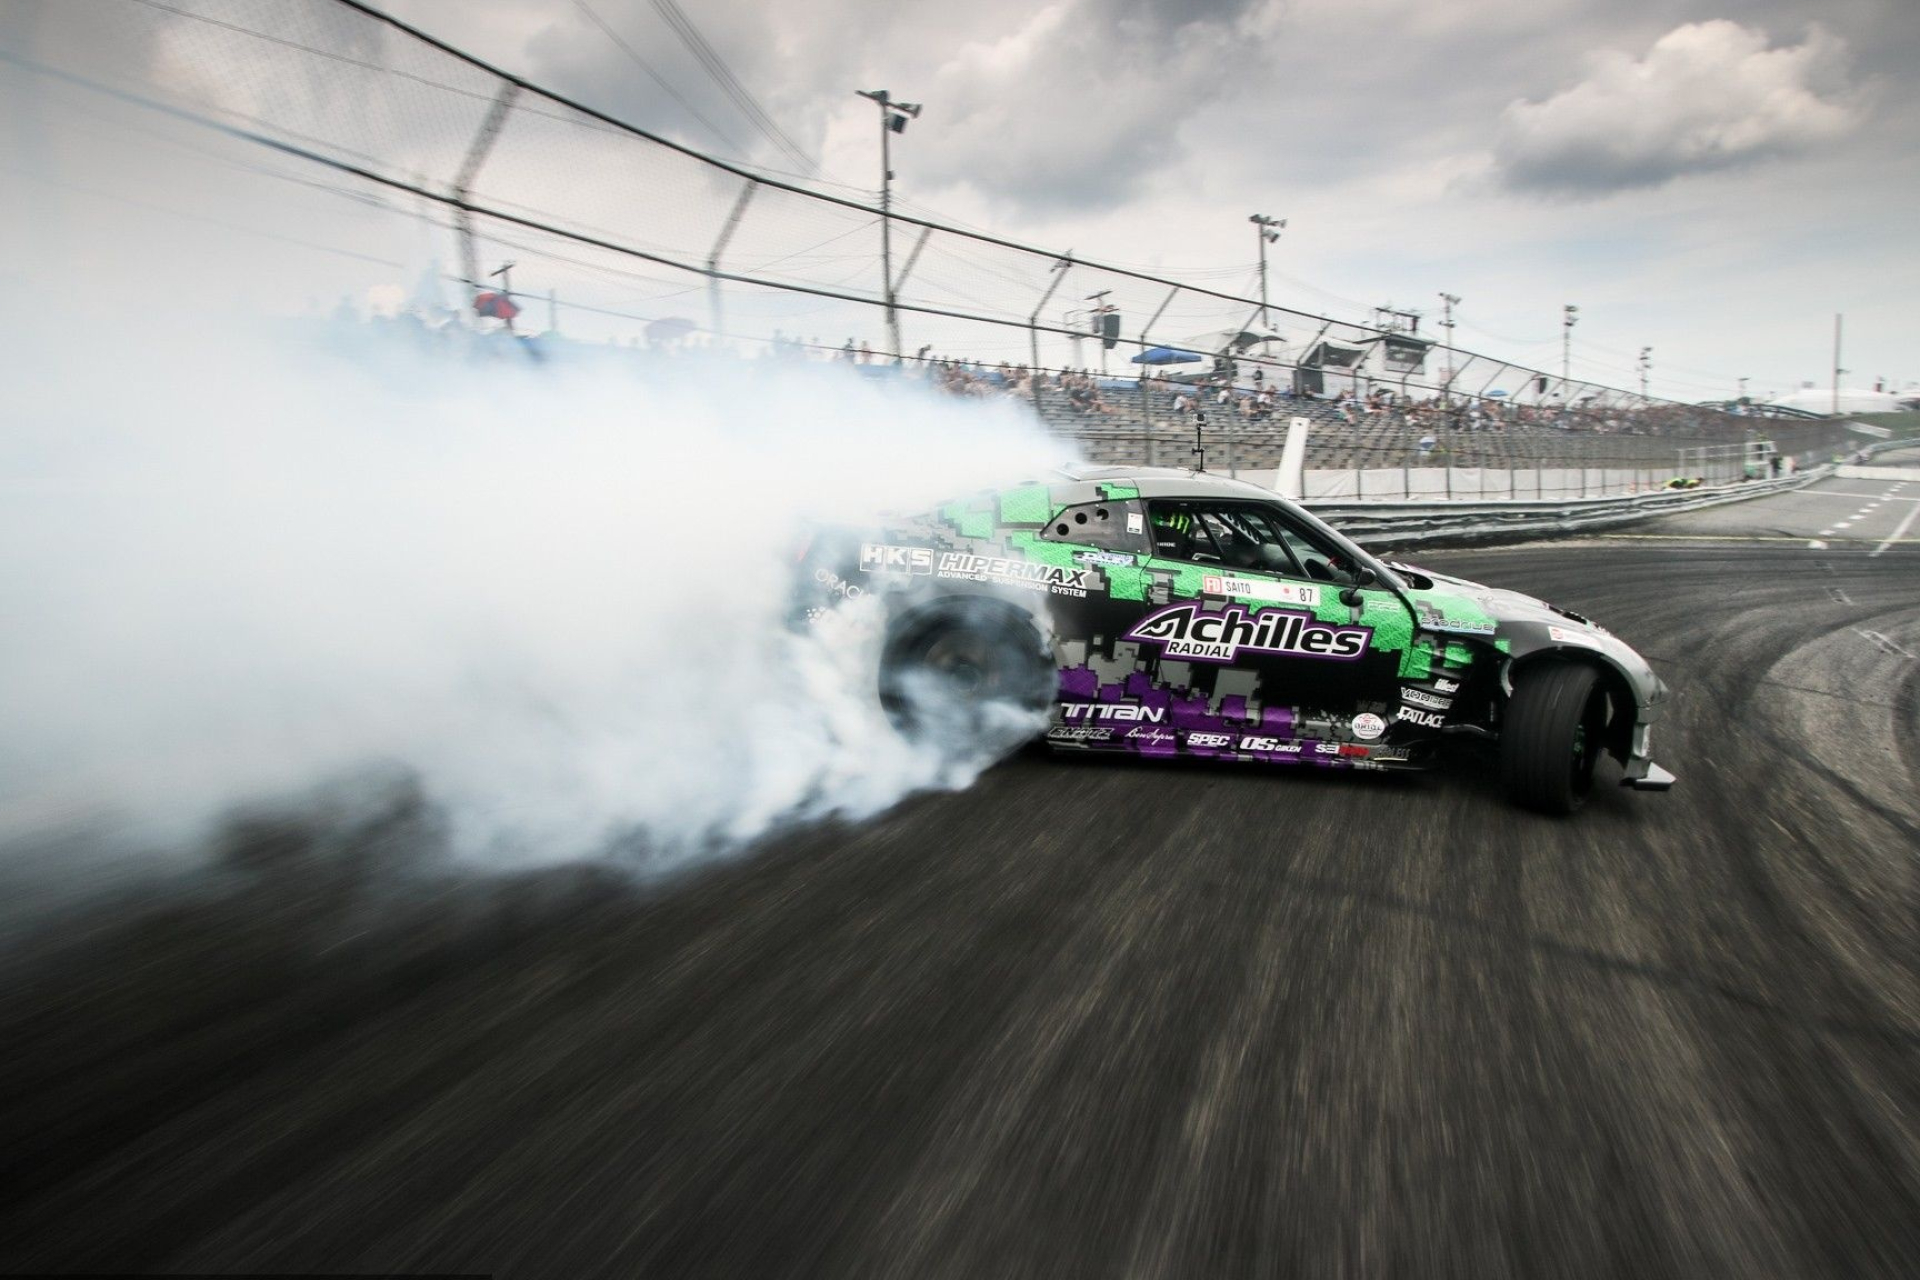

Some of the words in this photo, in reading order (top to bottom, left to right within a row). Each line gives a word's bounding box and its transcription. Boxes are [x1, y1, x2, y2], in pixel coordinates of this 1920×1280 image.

[861, 544, 933, 567] HKS
[938, 551, 1092, 589] HIPERMAX
[814, 568, 871, 600] ORAC
[937, 571, 986, 582] ADVANCED
[992, 576, 1048, 593] SUSPENSION
[1049, 585, 1087, 598] SYSTEM
[1225, 581, 1251, 595] SAITO
[1299, 587, 1313, 602] 87
[1133, 604, 1365, 657] Achilles
[1168, 641, 1232, 659] RADIAL
[1397, 705, 1446, 729] FATLACE
[1187, 733, 1231, 747] SPEC
[1240, 737, 1278, 751] OS
